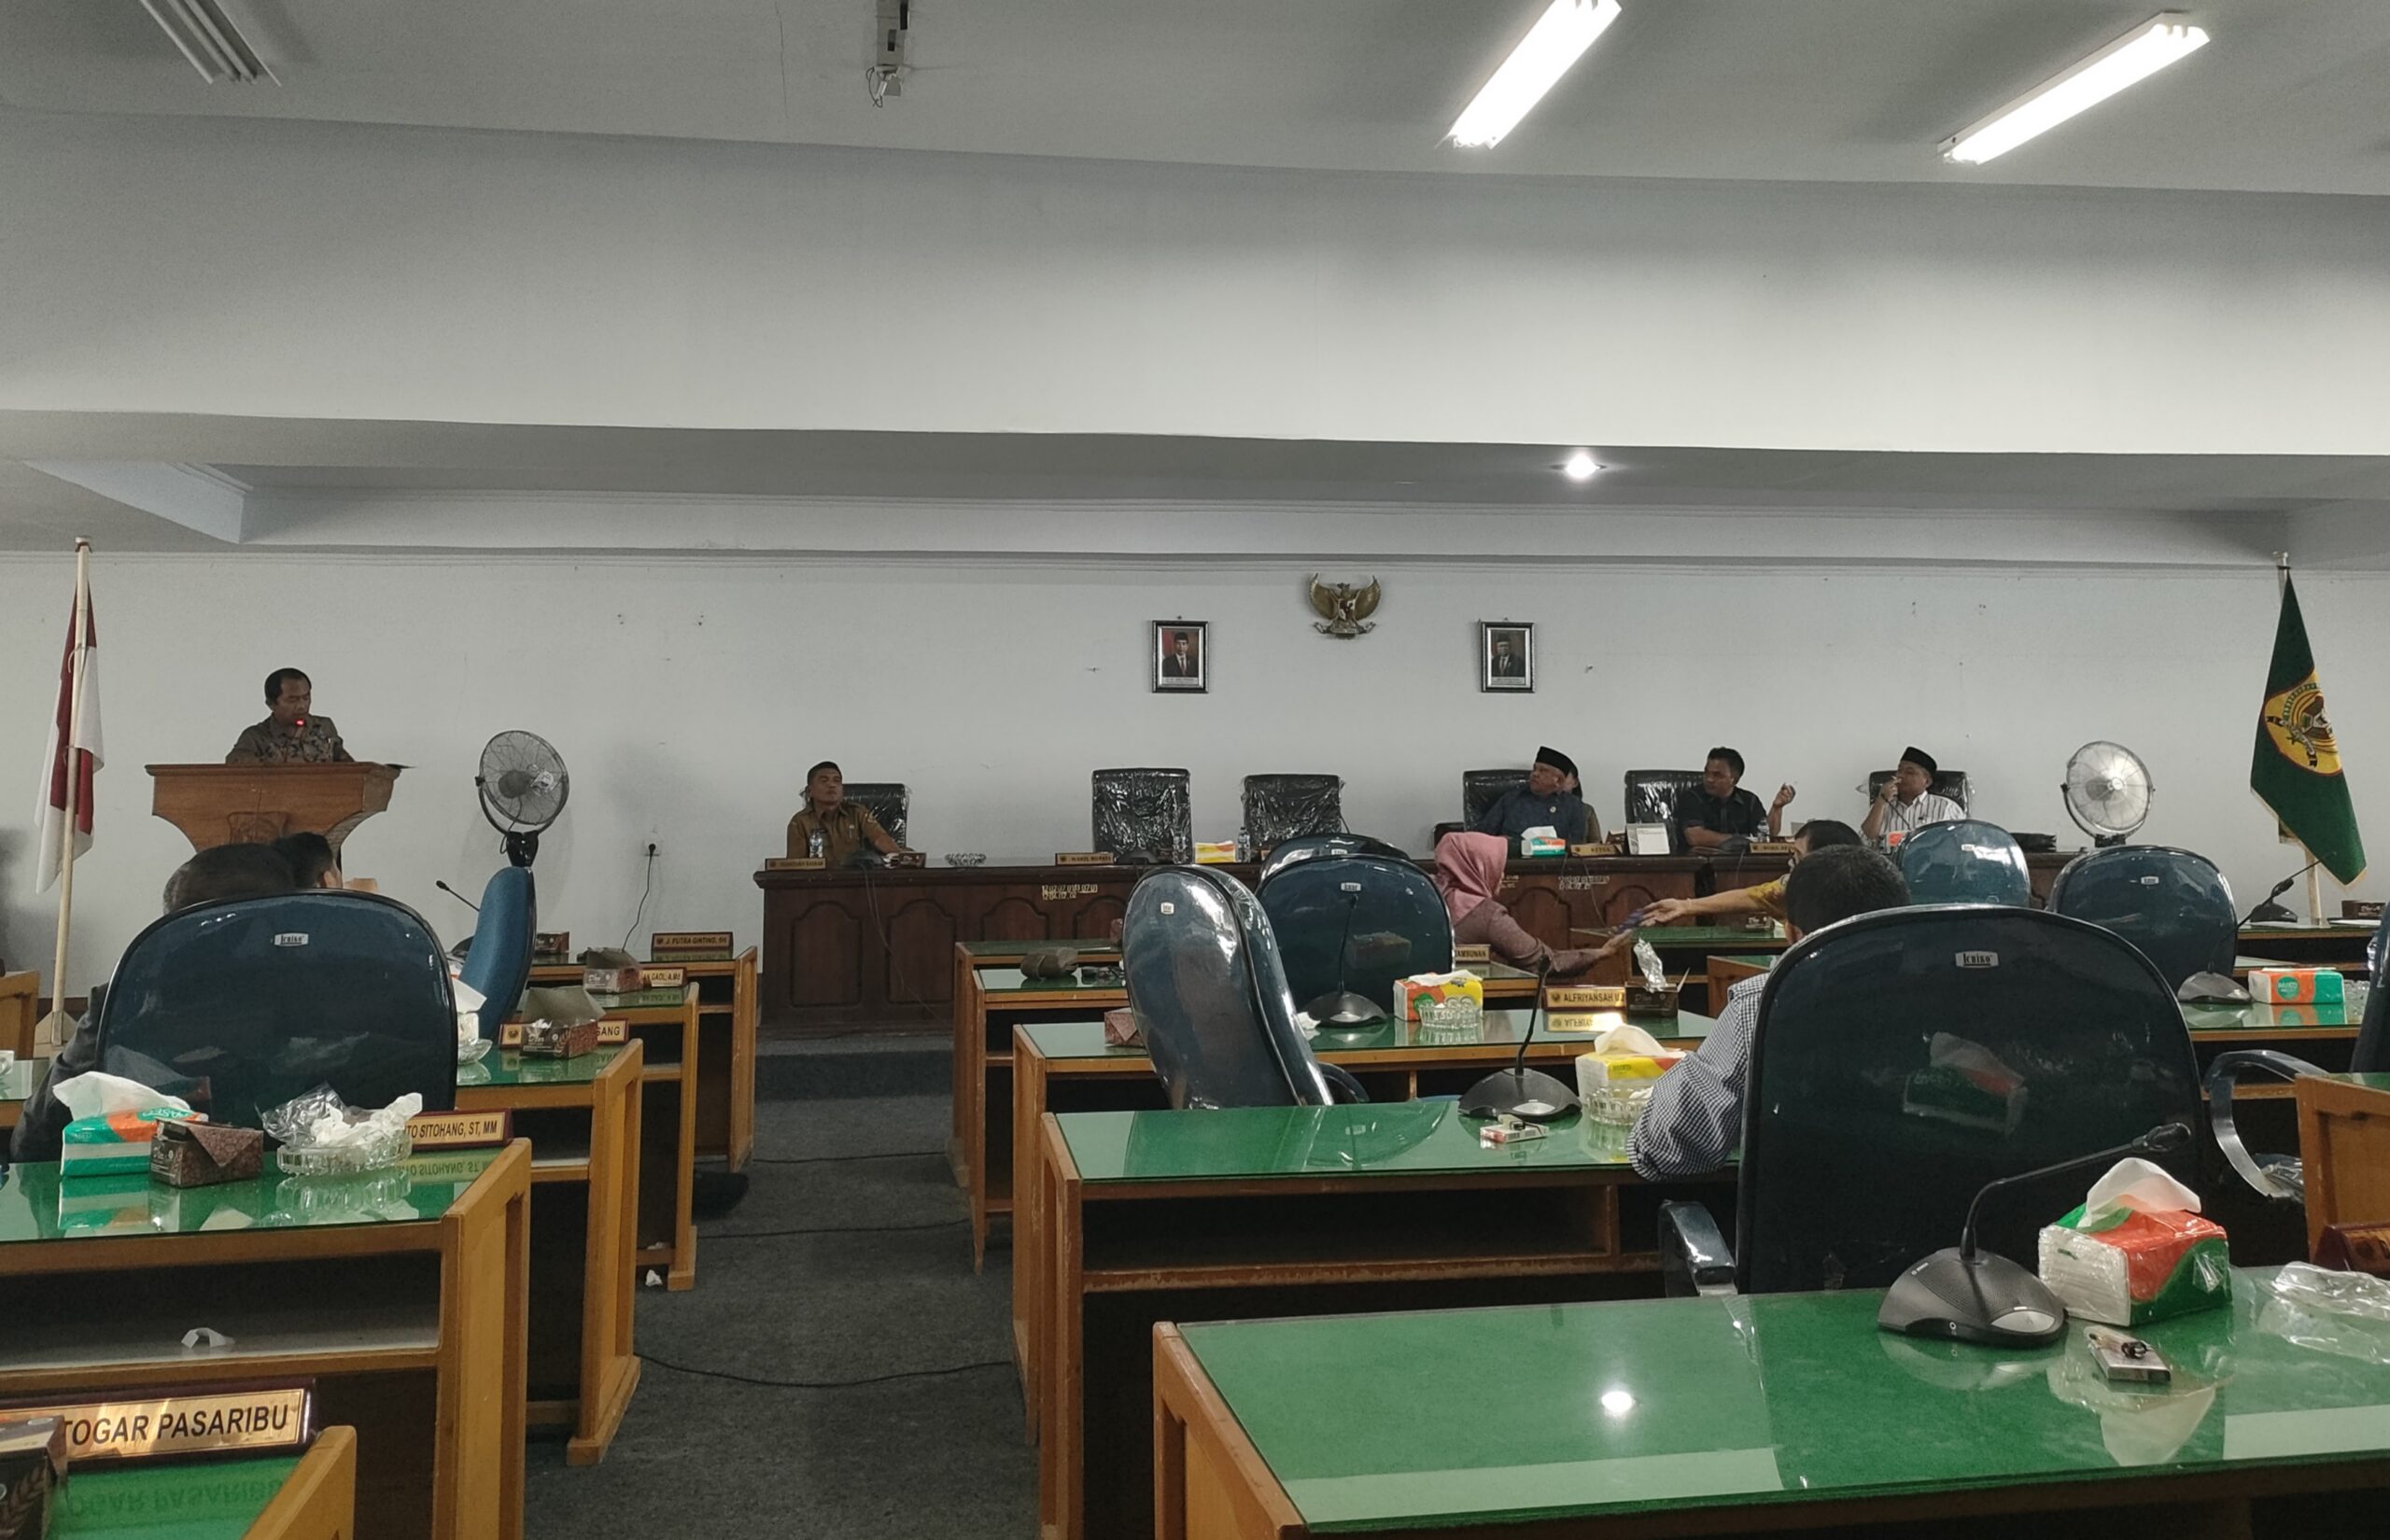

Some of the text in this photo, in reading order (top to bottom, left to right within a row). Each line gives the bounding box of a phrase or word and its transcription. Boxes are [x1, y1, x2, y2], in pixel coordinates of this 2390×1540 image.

[1563, 992, 1614, 1002] ALFRIYANSAH
[419, 1121, 467, 1138] SITOHANG,
[468, 1121, 481, 1137] ST,
[483, 1119, 498, 1134] MM
[156, 1403, 289, 1439] PASARIBU
